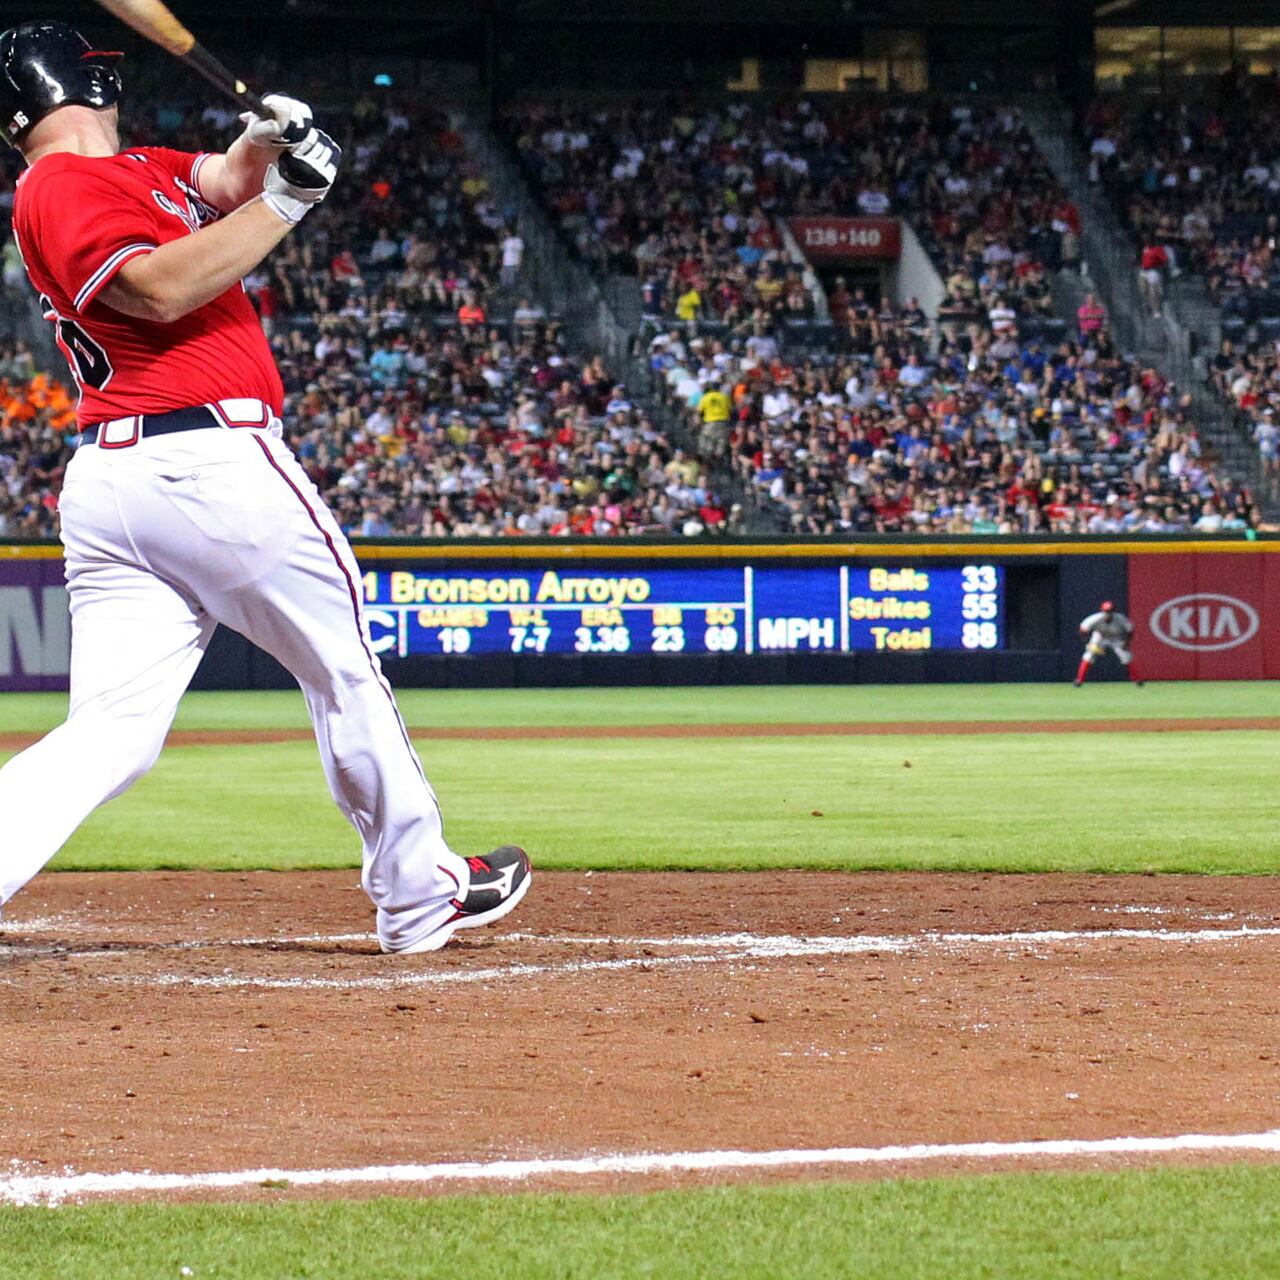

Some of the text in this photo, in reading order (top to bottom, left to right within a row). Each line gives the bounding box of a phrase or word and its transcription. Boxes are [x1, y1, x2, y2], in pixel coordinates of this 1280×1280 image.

[391, 571, 530, 603] Bronson
[535, 570, 650, 608] Arroyo
[869, 566, 997, 592] Balls 33
[581, 608, 623, 626] ERA
[849, 594, 997, 620] Strikes 55
[758, 618, 834, 649] MPH
[1167, 605, 1241, 639] KIA
[437, 626, 738, 653] 19 7-7 3.36 23 69
[871, 622, 997, 650] Total 88
